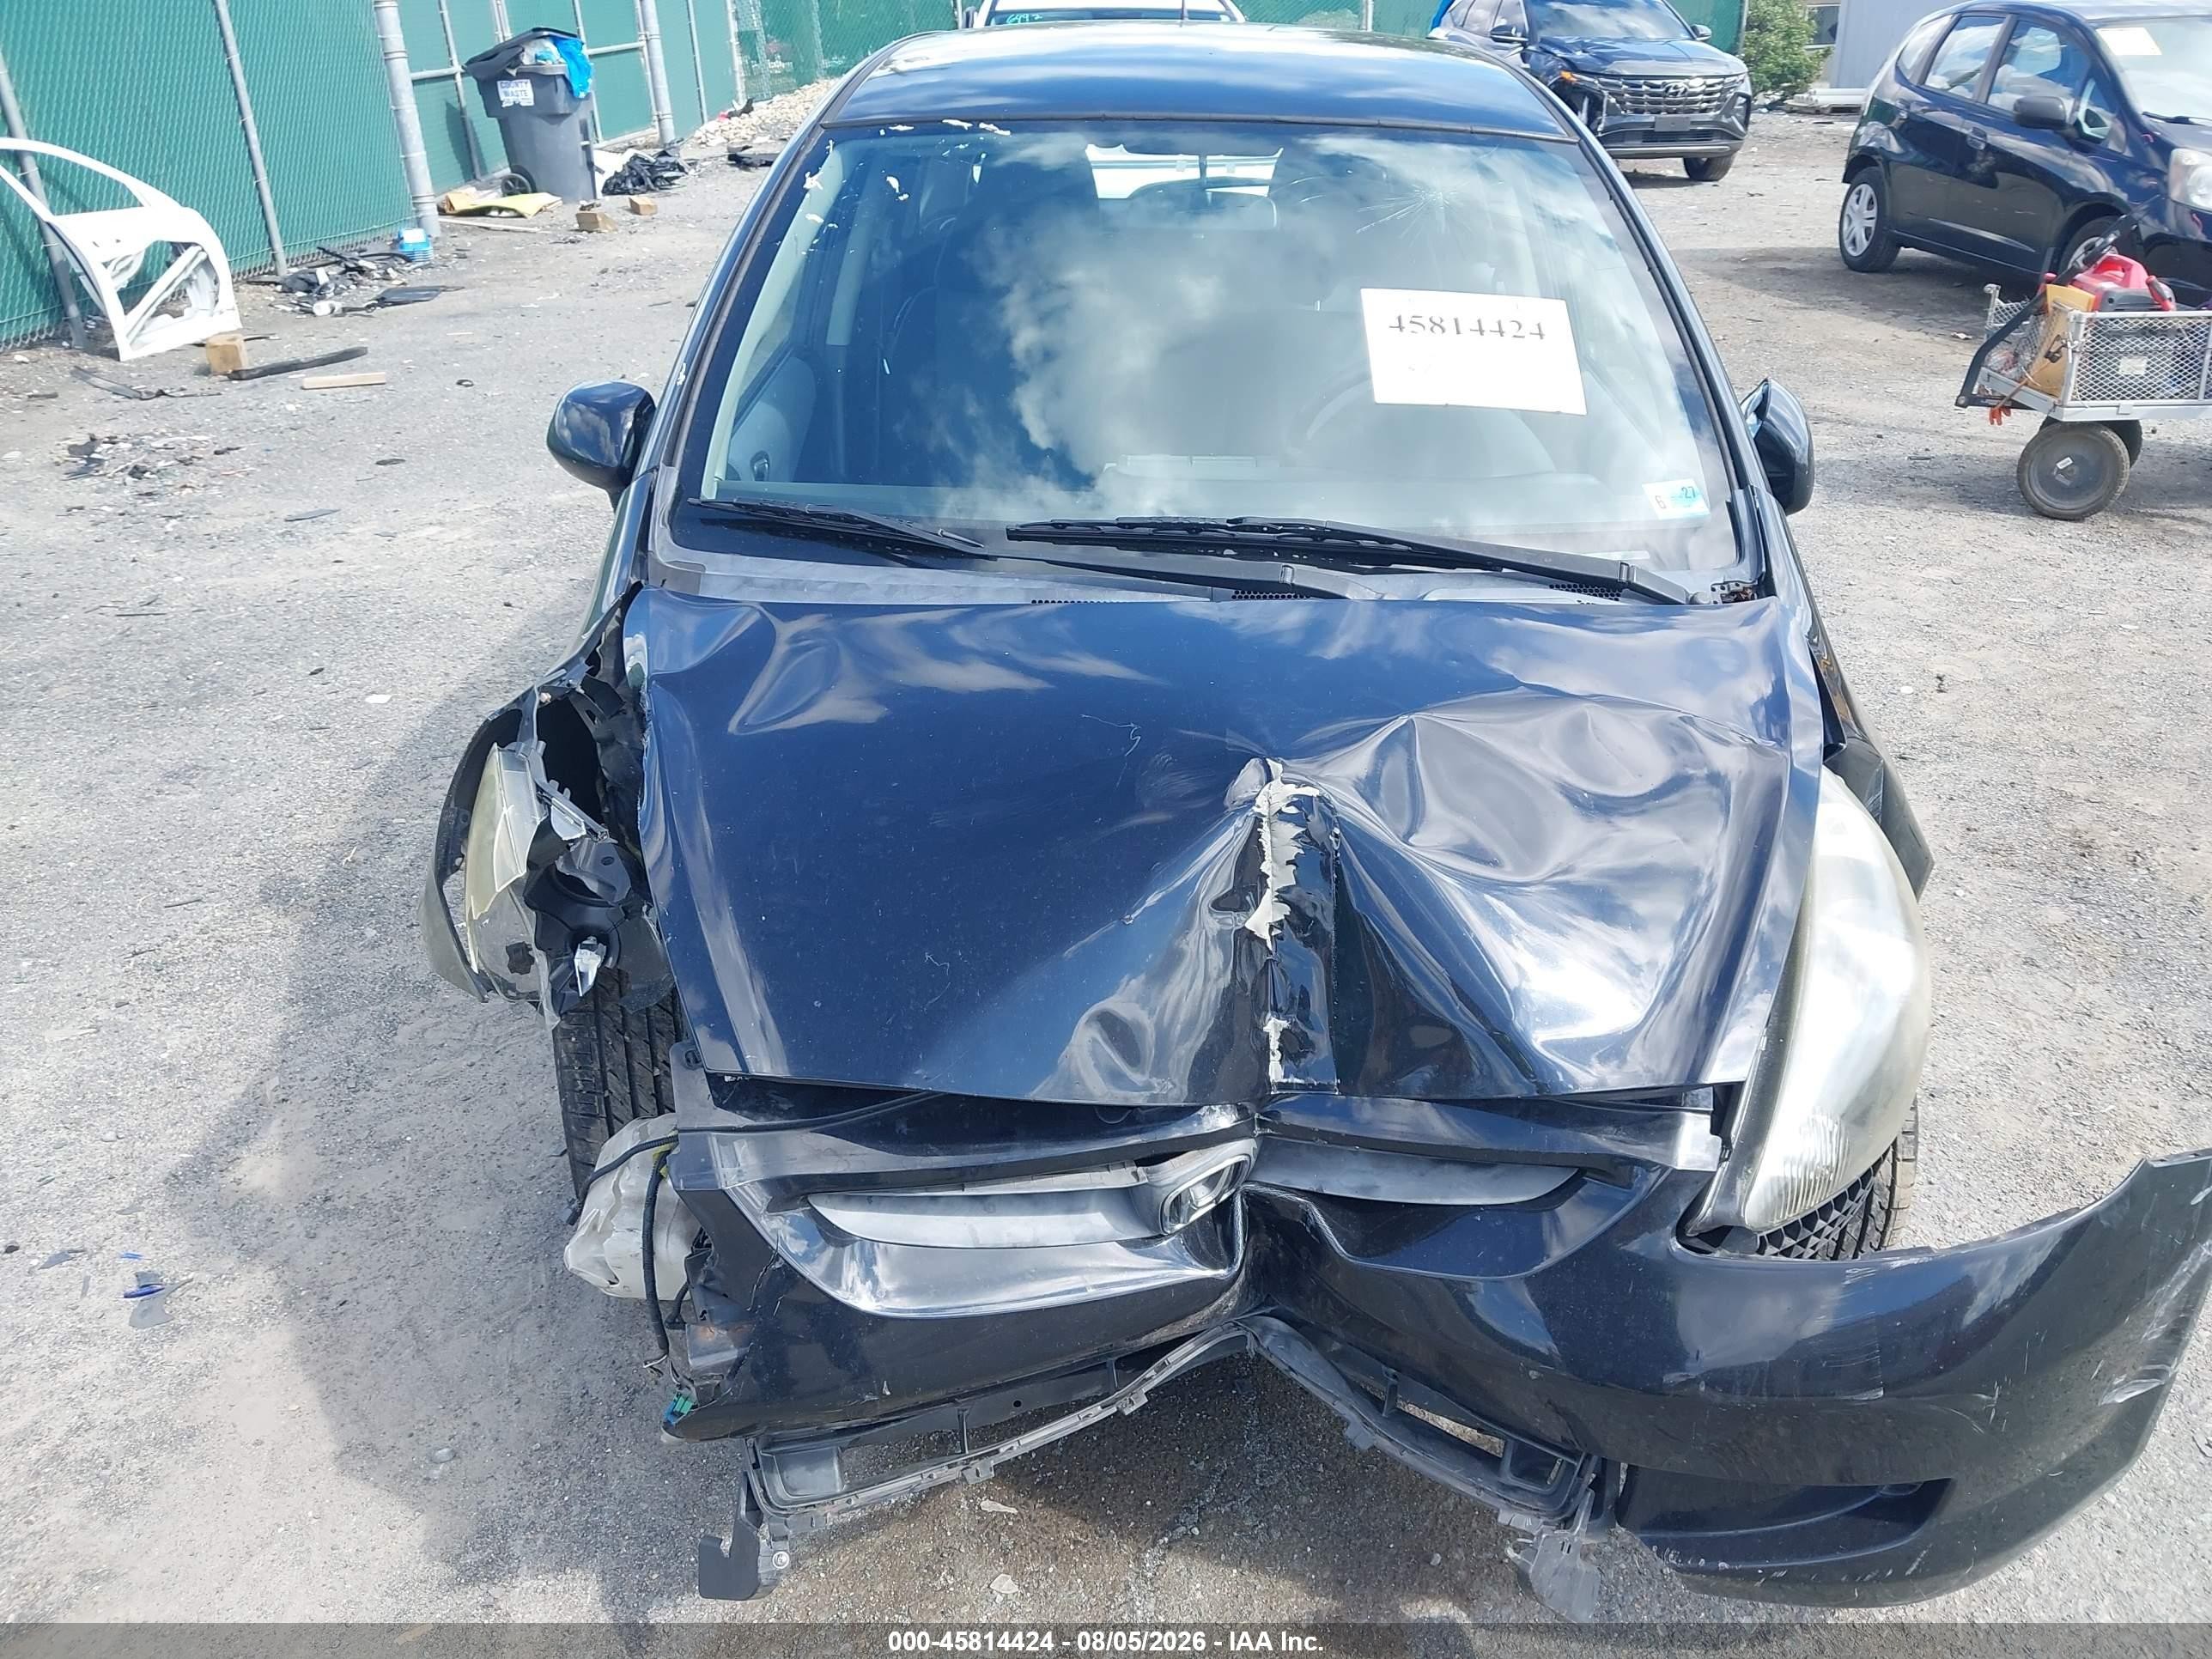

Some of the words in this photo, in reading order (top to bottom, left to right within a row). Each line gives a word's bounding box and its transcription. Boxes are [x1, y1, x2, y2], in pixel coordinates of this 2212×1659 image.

[1389, 314, 1545, 339] 45814424
[1681, 486, 1696, 499] 27
[1655, 495, 1667, 509] 6
